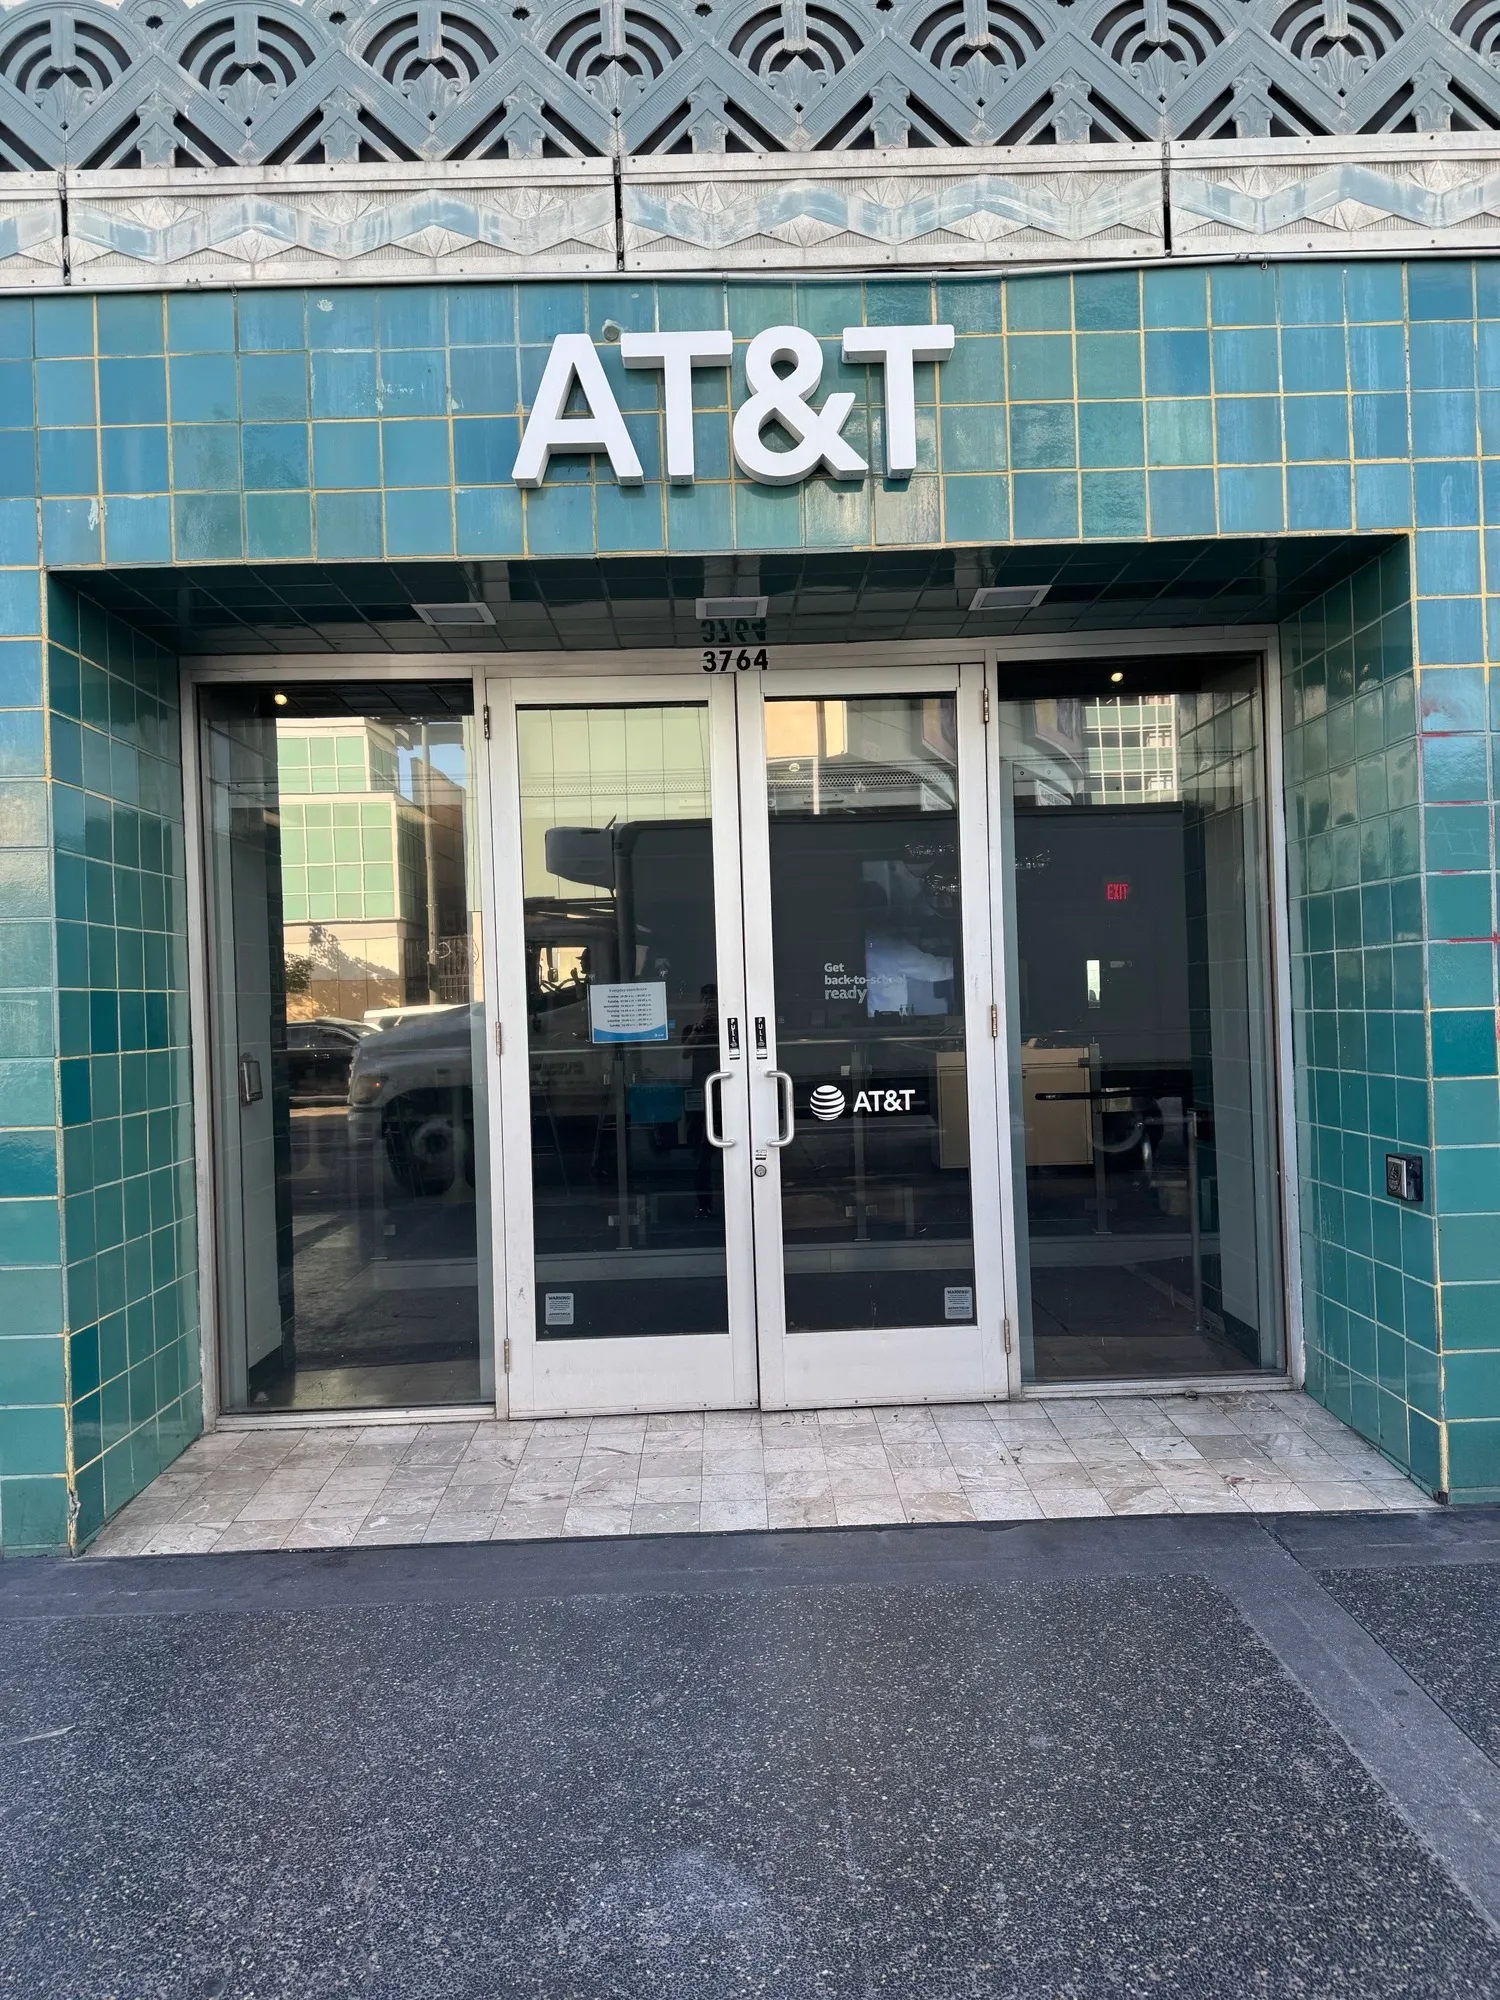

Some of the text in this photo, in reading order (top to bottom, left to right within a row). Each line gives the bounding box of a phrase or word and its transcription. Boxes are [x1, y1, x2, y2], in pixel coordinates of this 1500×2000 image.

[512, 325, 955, 488] AT&T
[702, 648, 768, 672] 3764
[1107, 883, 1128, 900] EXIT
[824, 962, 844, 973] Get
[824, 985, 867, 1004] ready
[853, 1089, 916, 1113] AT&T
